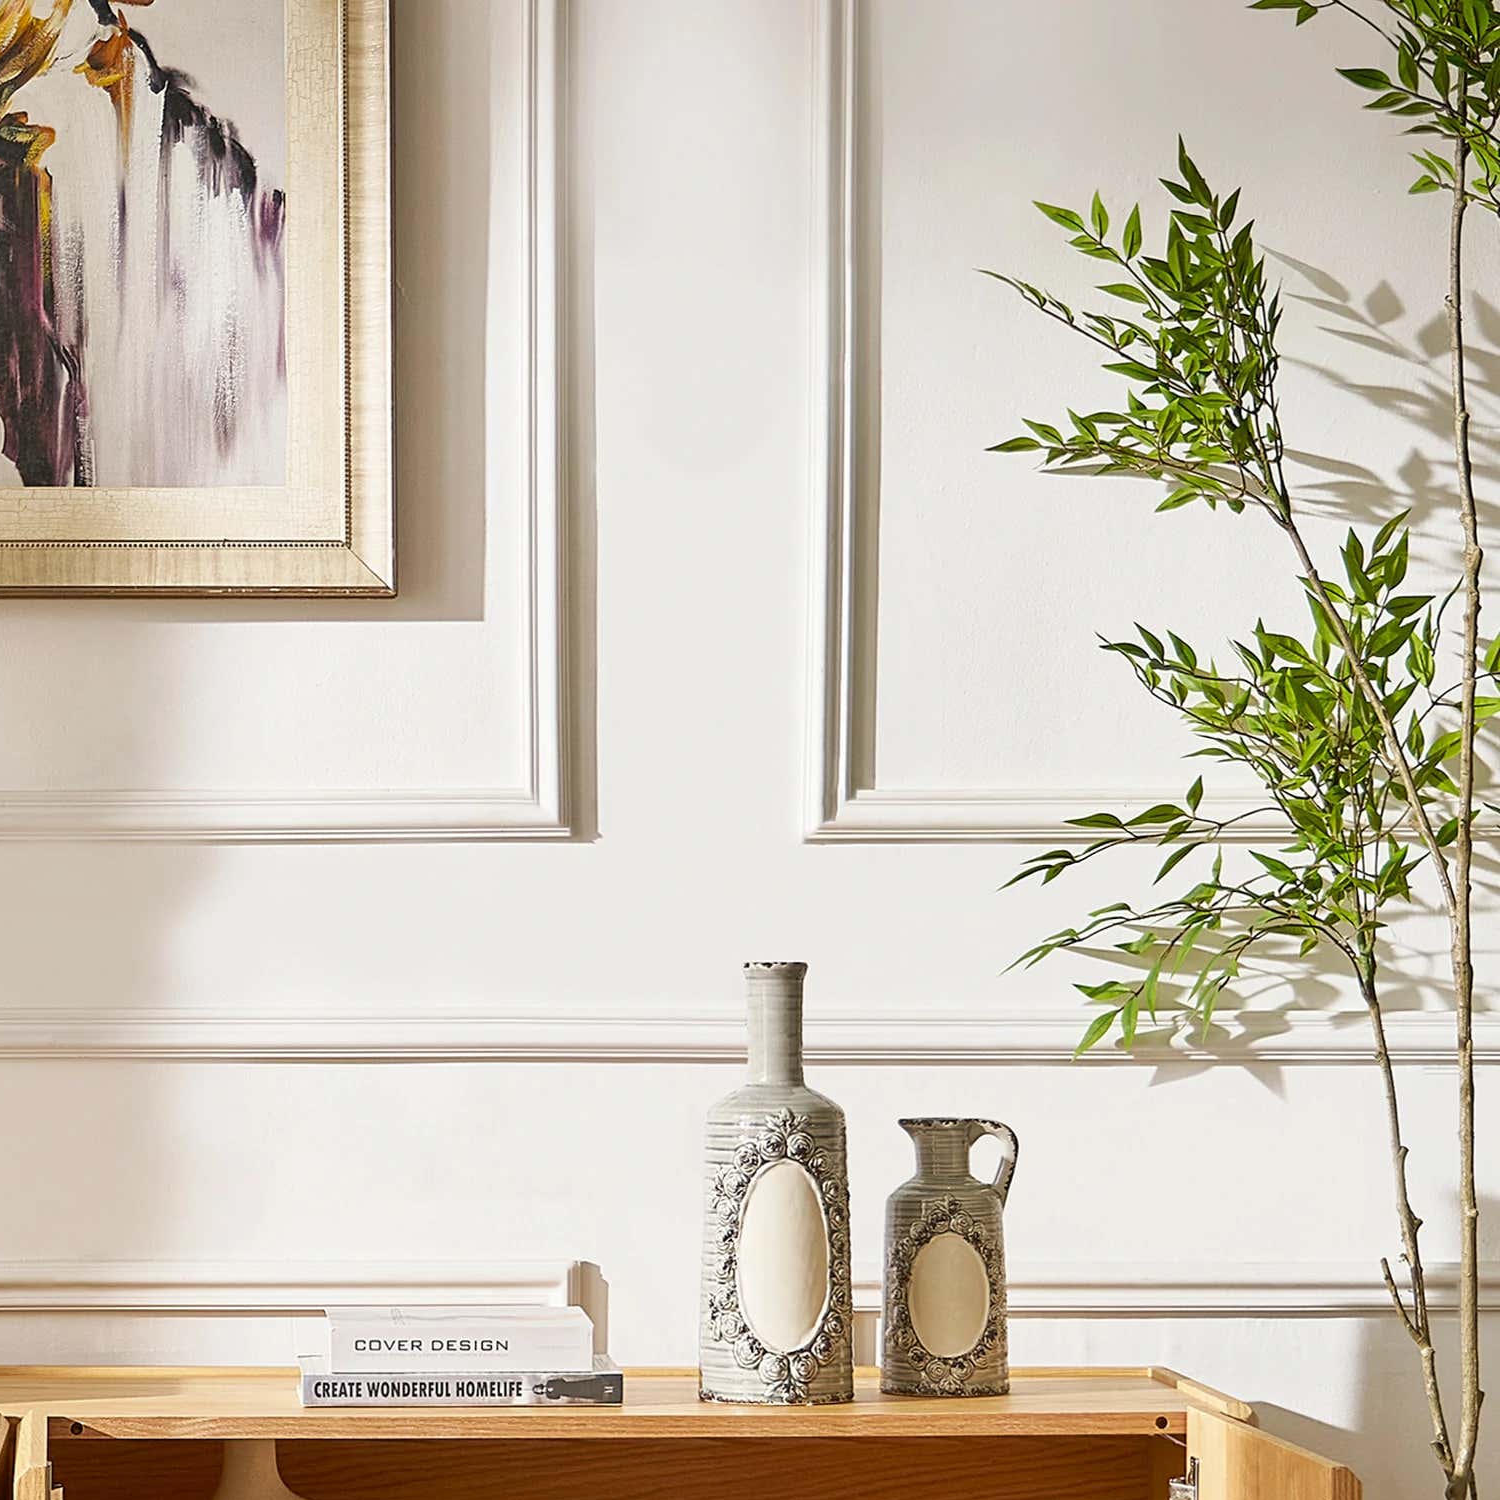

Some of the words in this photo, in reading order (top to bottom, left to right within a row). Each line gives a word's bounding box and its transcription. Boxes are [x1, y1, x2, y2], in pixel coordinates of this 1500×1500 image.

[354, 1339, 423, 1352] COVER
[431, 1339, 509, 1352] DESIGN
[313, 1380, 363, 1399] CREATE
[366, 1380, 451, 1399] WONDERFUL
[456, 1380, 523, 1399] HOMELIFE
